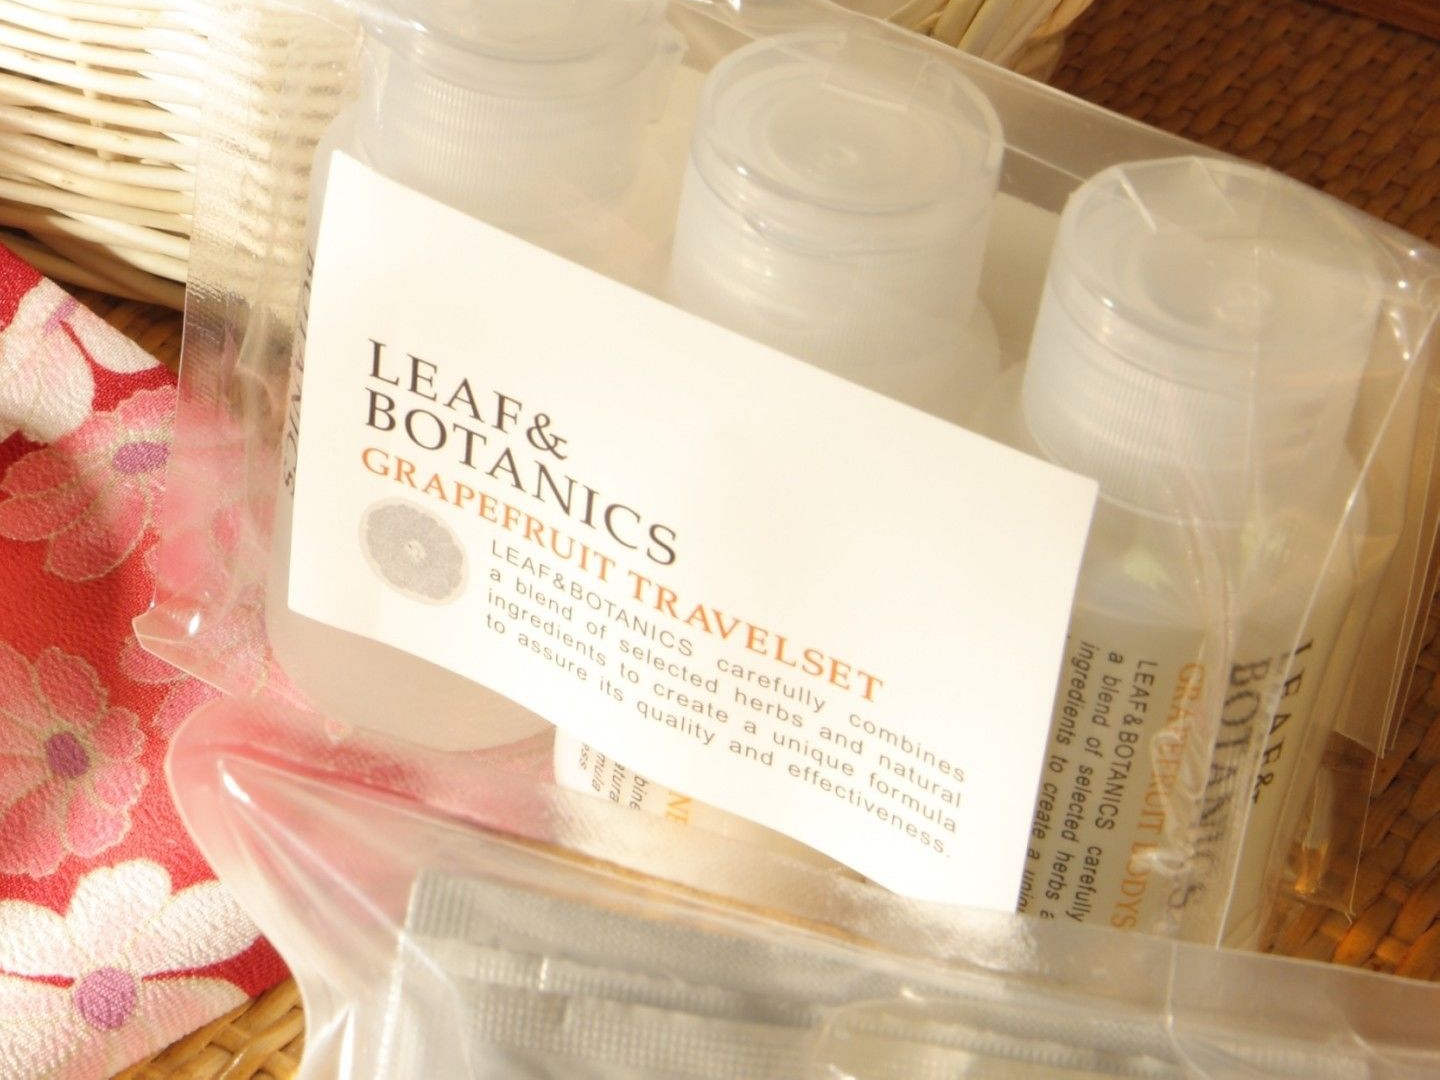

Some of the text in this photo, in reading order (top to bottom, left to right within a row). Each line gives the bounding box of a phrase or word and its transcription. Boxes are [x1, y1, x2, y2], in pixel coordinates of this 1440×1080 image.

[368, 338, 568, 461] LEAF&
[365, 387, 677, 566] BOTANICS
[362, 447, 884, 703] GRAPEFRUIT TRAVELSET
[490, 568, 961, 808] a blend of selected herbs and natural
[492, 539, 966, 783] LEAF&BOTANICS carefully combines
[1056, 641, 1100, 745] ingredients
[1092, 674, 1122, 728] blend
[1108, 651, 1124, 665] a
[486, 613, 951, 858] to assure its quality and effectiveness.
[488, 588, 956, 833] ingredients to create a unique formula
[1085, 737, 1103, 758] of
[1049, 754, 1068, 774] to
[1061, 765, 1093, 843] selected
[1032, 782, 1058, 839] create
[1046, 851, 1074, 901] herbs
[1066, 846, 1102, 922] carefully
